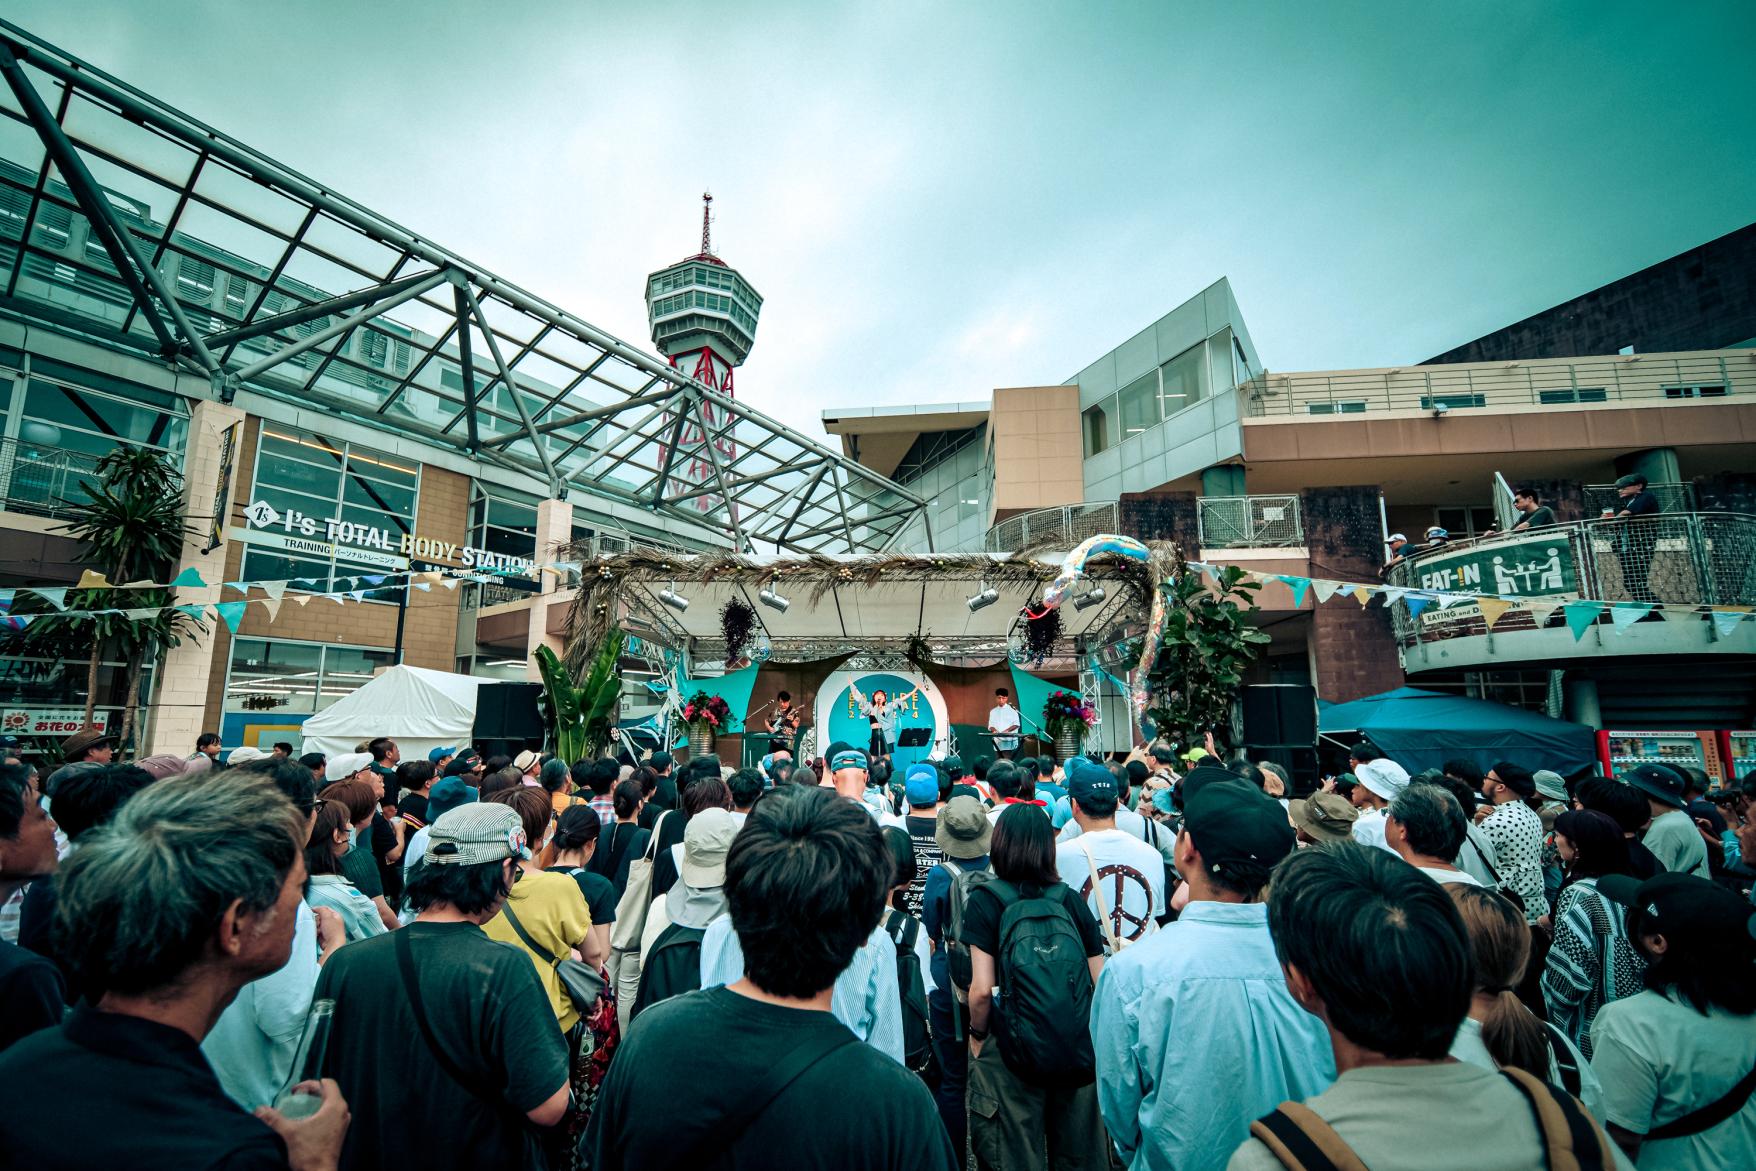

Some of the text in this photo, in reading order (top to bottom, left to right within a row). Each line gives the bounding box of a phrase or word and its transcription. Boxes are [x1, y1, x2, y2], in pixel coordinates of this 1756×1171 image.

[284, 508, 536, 577] I's TOTAL BODY STATION
[284, 538, 330, 555] TRAINING
[334, 549, 396, 565] パーソナルトレーニング
[1427, 609, 1471, 622] EATING and
